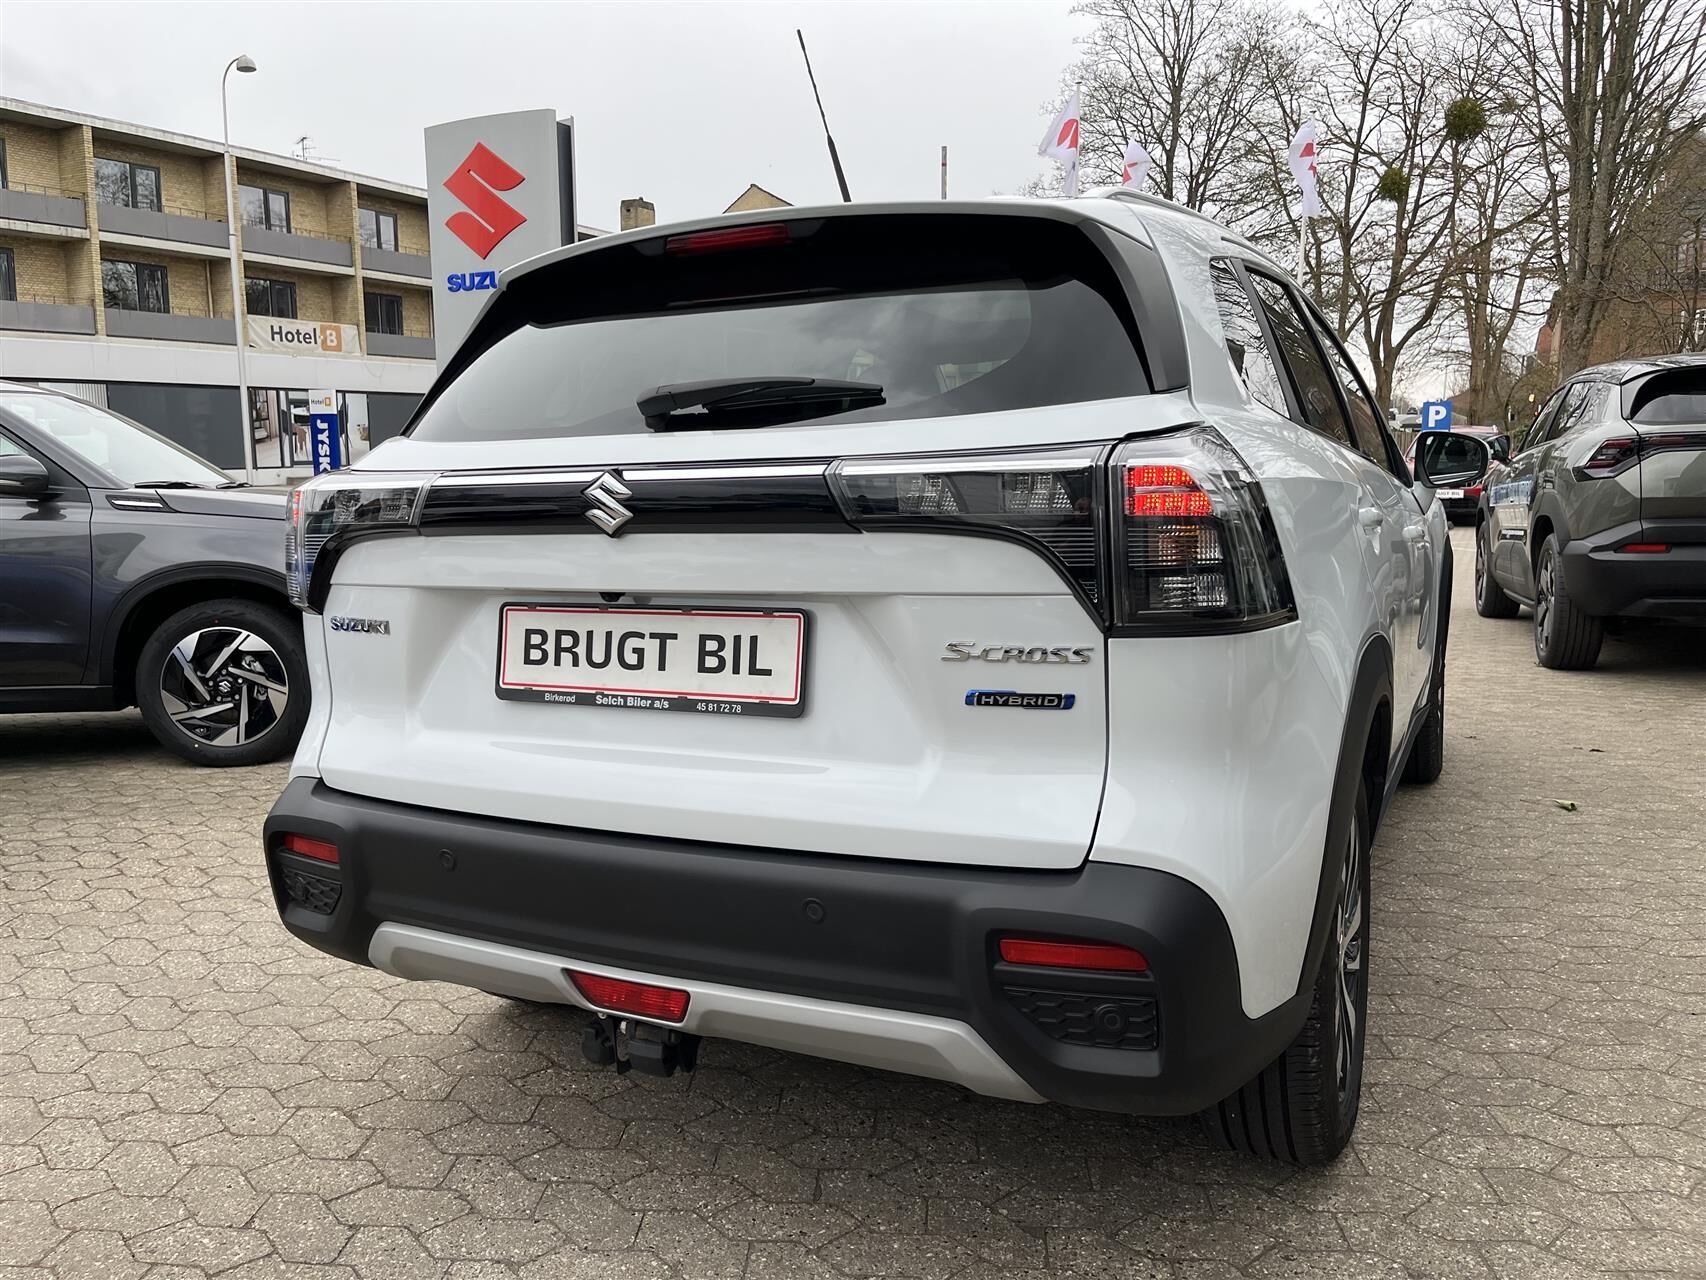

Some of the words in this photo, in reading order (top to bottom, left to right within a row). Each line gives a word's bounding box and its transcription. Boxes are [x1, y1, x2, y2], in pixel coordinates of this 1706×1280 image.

[270, 324, 318, 345] Hotel
[1428, 405, 1447, 428] P
[316, 418, 331, 473] JYSK
[330, 615, 391, 635] SUZUKI
[523, 628, 679, 671] BRUGT
[697, 633, 773, 677] BIL
[940, 640, 1095, 664] S-CROSS
[595, 694, 624, 706] Selch
[626, 696, 652, 707] Biler
[653, 699, 669, 709] a/s
[696, 702, 707, 711] 45
[707, 703, 718, 712] 81
[719, 703, 730, 713] 72
[731, 704, 742, 713] 78
